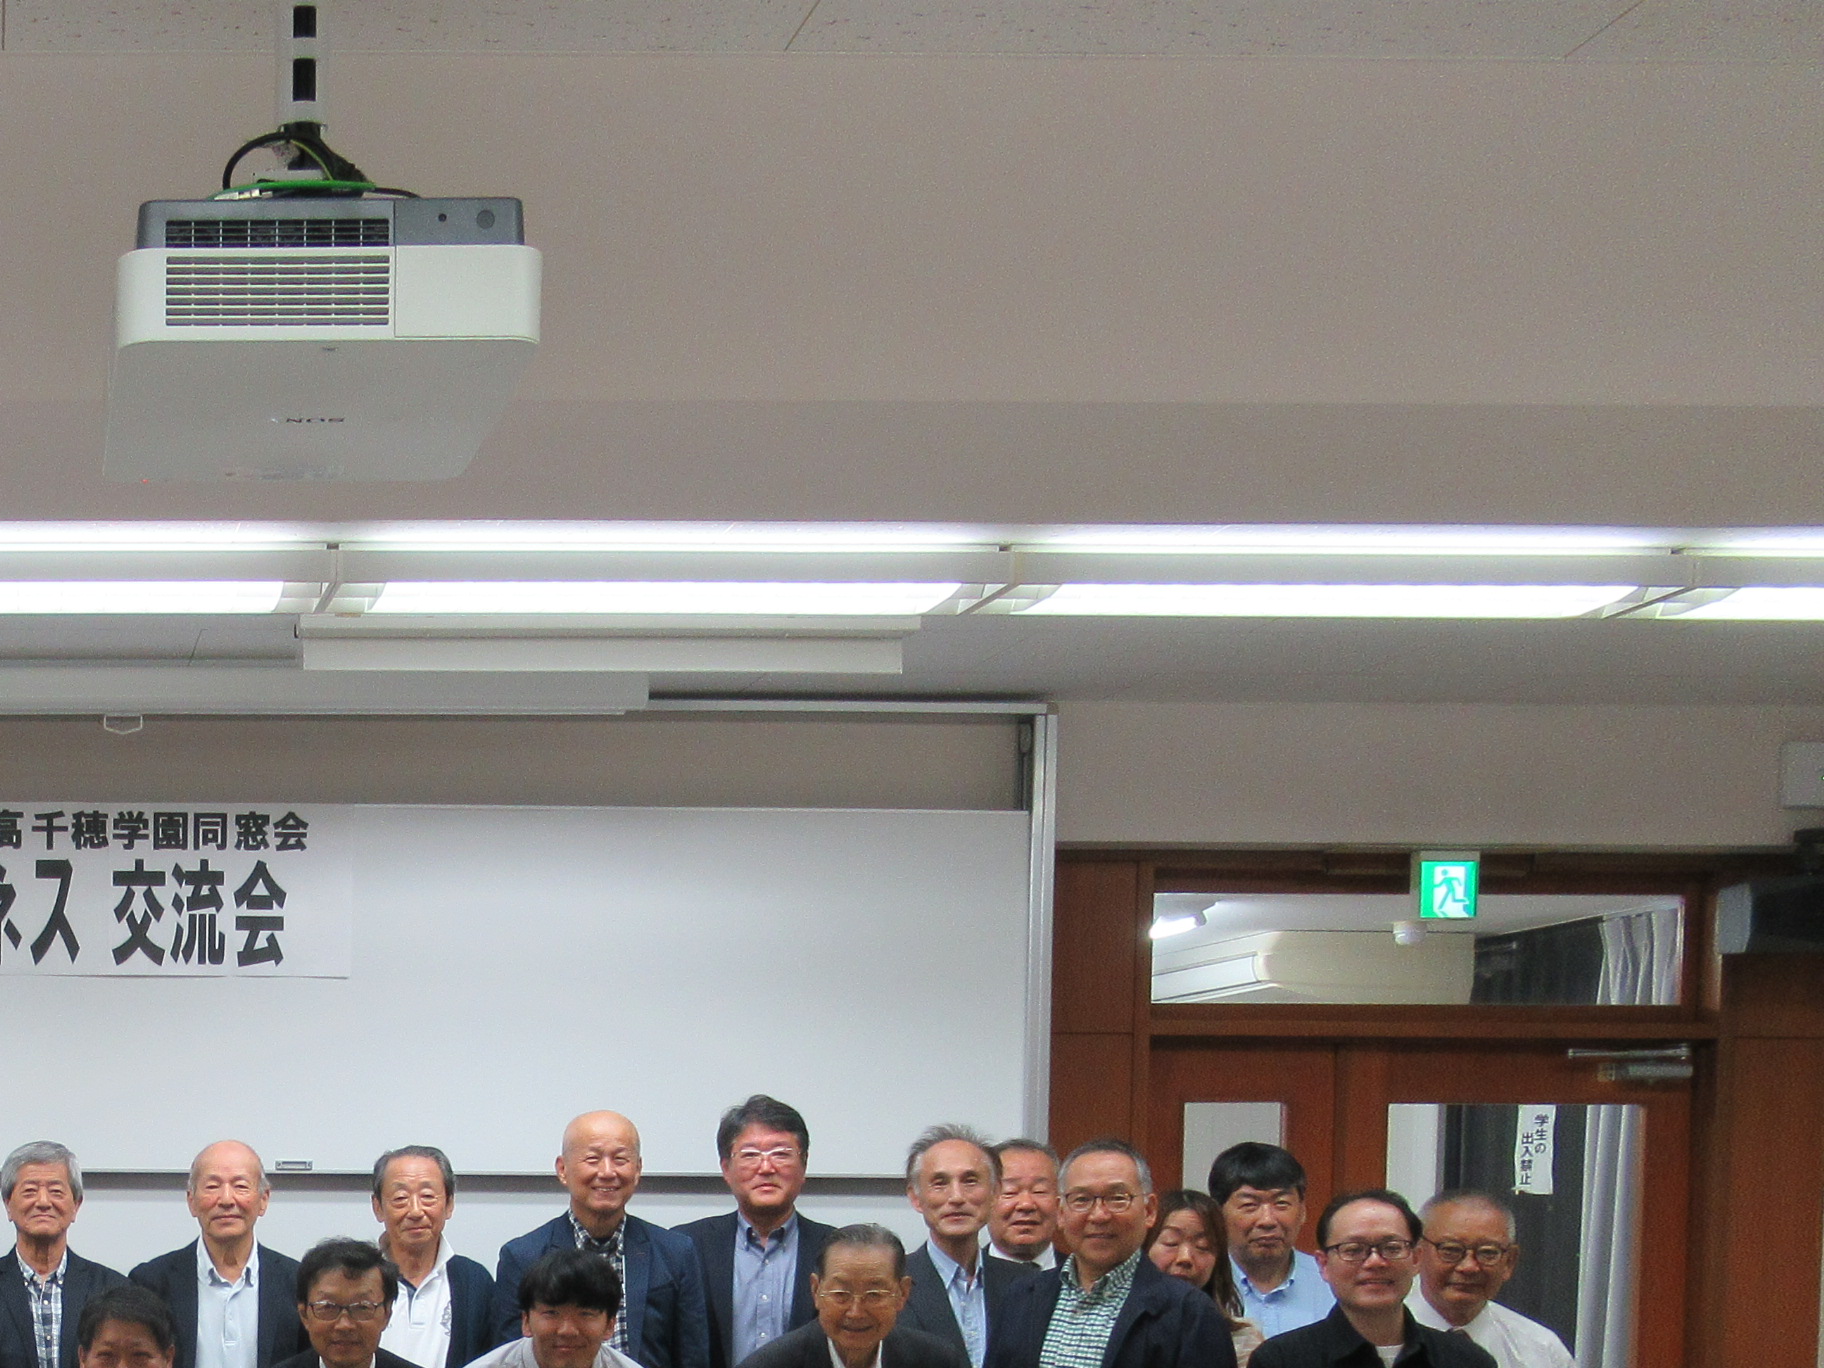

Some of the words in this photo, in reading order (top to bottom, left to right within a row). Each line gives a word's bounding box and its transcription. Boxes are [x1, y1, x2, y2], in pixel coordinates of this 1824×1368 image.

[112, 858, 287, 967] 交流会
[1520, 1132, 1534, 1185] 出入禁止
[1534, 1114, 1549, 1153] 学生の
